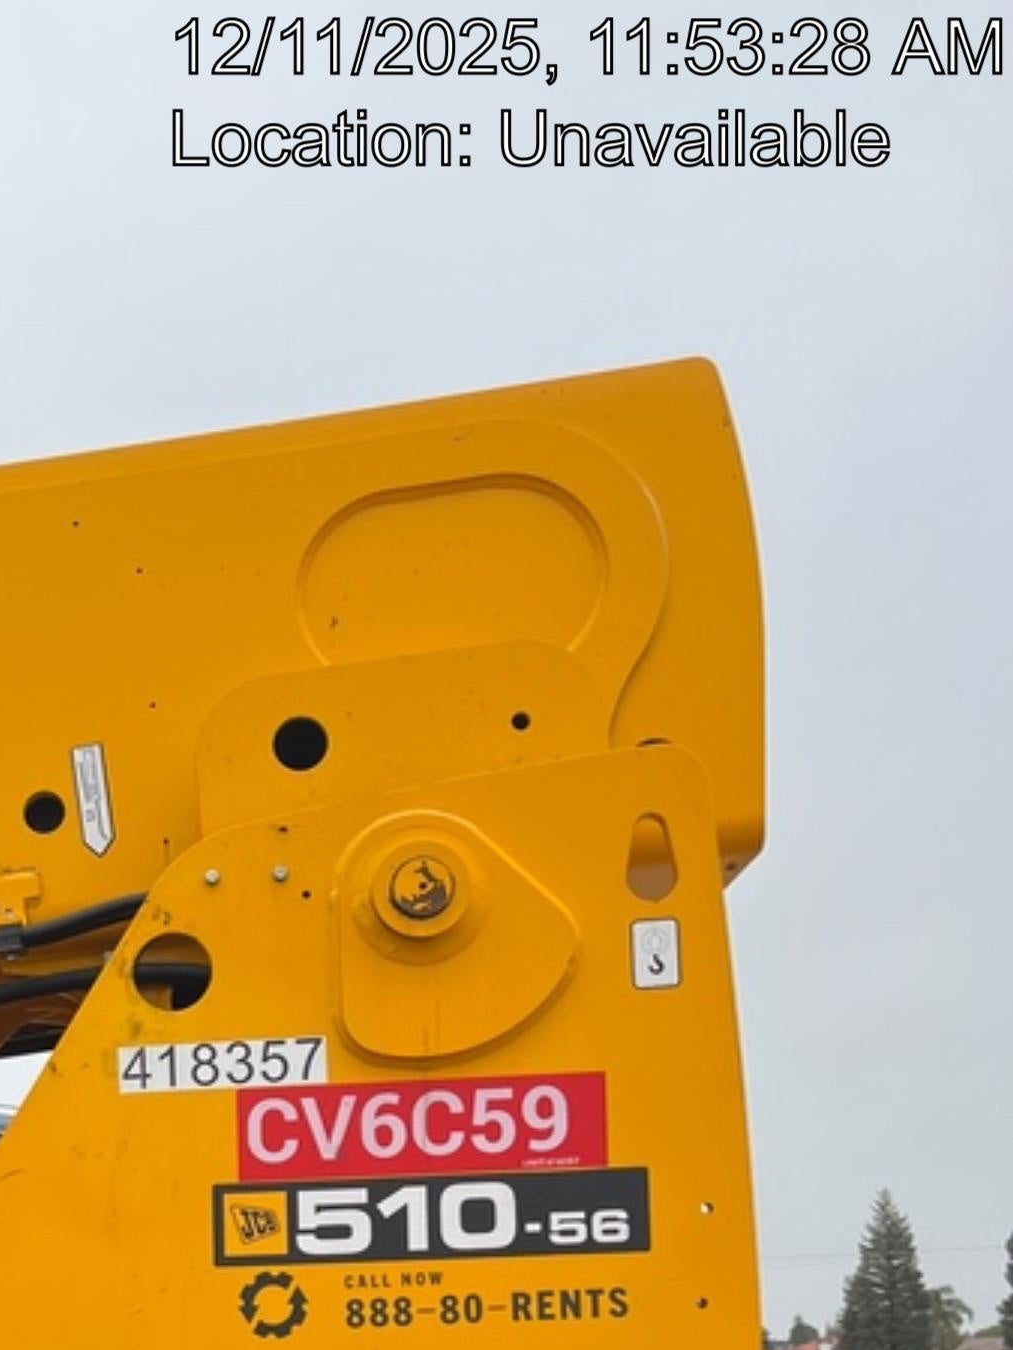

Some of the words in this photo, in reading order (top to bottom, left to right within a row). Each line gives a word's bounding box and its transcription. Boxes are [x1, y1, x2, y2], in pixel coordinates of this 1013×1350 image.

[122, 1037, 323, 1089] 418357
[245, 1084, 569, 1165] CV6C59
[343, 1273, 391, 1290] CALL
[400, 1271, 444, 1287] NOW
[345, 1287, 629, 1329] 888-80-RENTS
